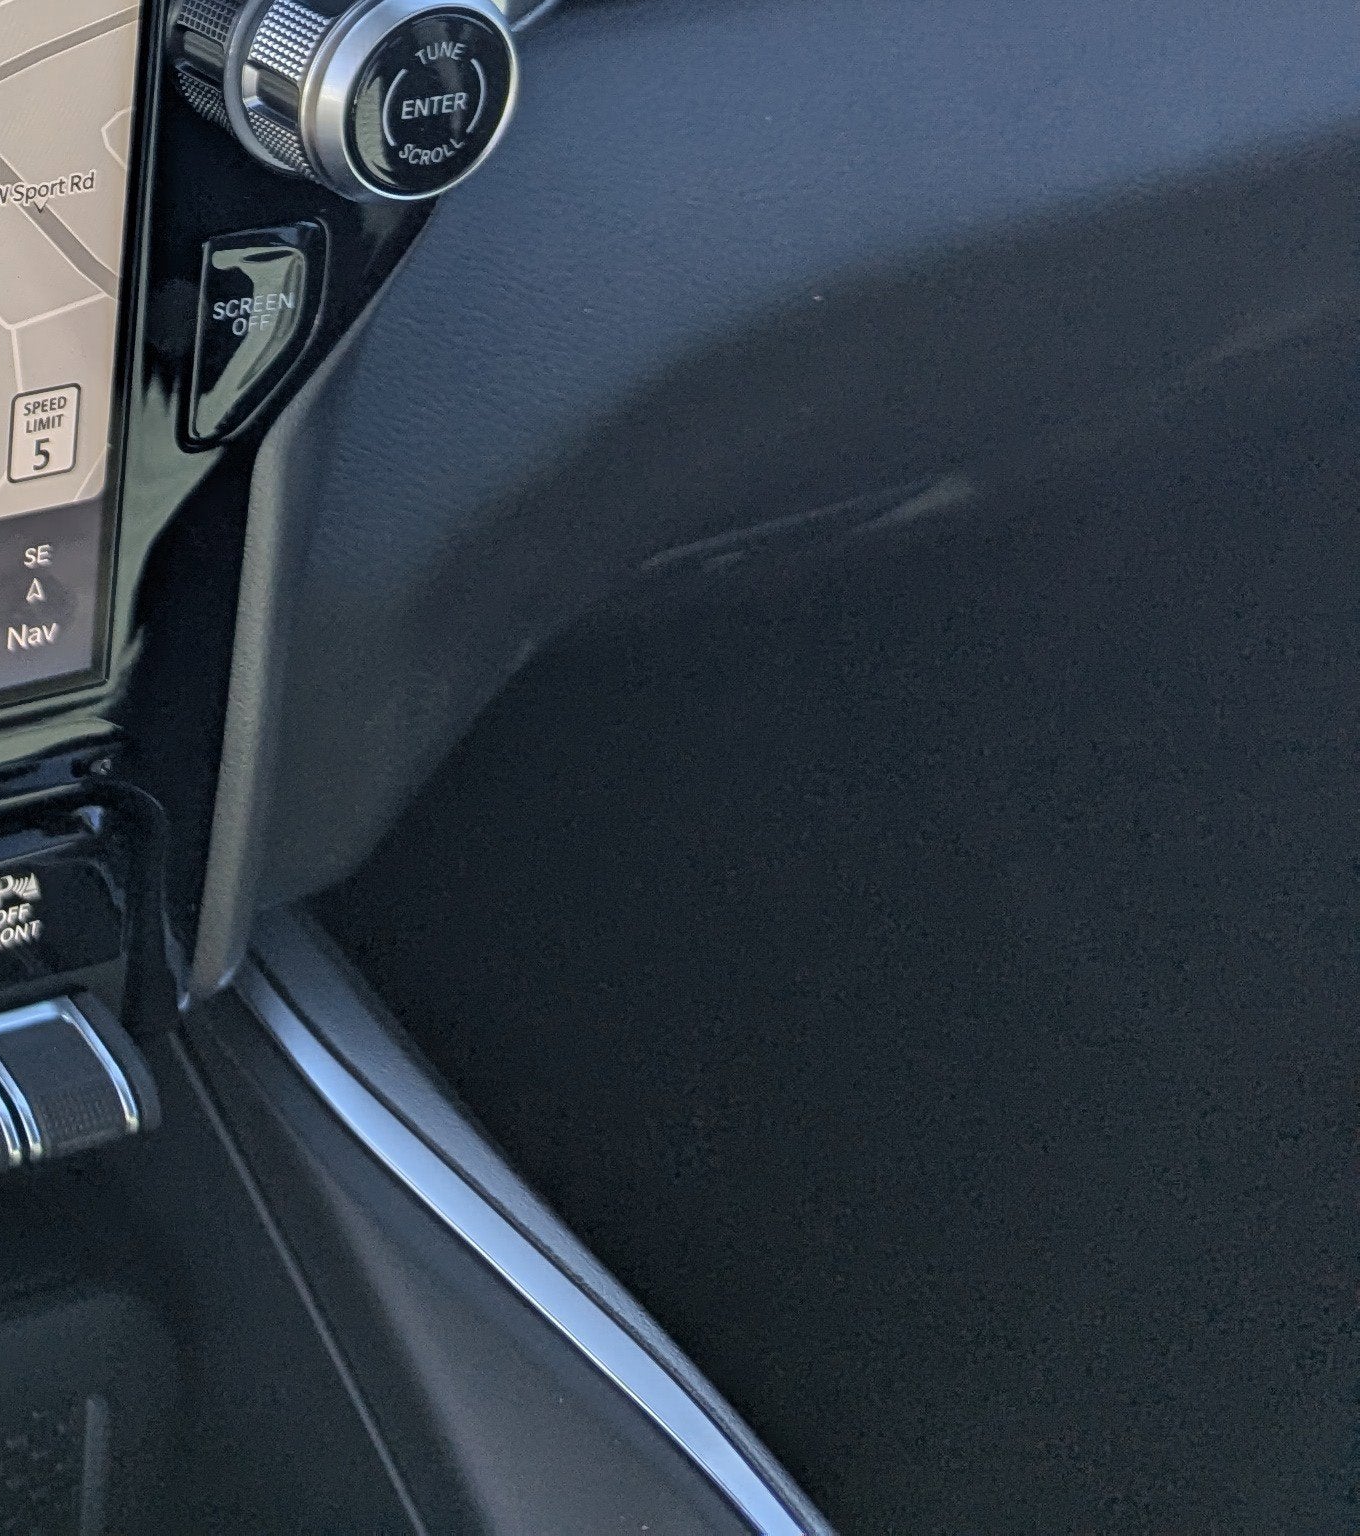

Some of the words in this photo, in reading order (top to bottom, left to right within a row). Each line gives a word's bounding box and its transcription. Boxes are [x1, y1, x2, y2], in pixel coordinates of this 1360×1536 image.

[414, 41, 467, 65] TUNE
[401, 92, 468, 120] ENTER
[399, 138, 465, 165] SCROLL
[13, 180, 65, 204] Sport
[71, 172, 95, 194] Rd
[212, 292, 295, 320] SCREEN
[232, 314, 271, 336] OFF
[23, 396, 67, 416] SPEED
[25, 414, 64, 434] LIMIT
[32, 438, 51, 471] 5
[23, 545, 52, 569] SE
[7, 621, 58, 652] Nav
